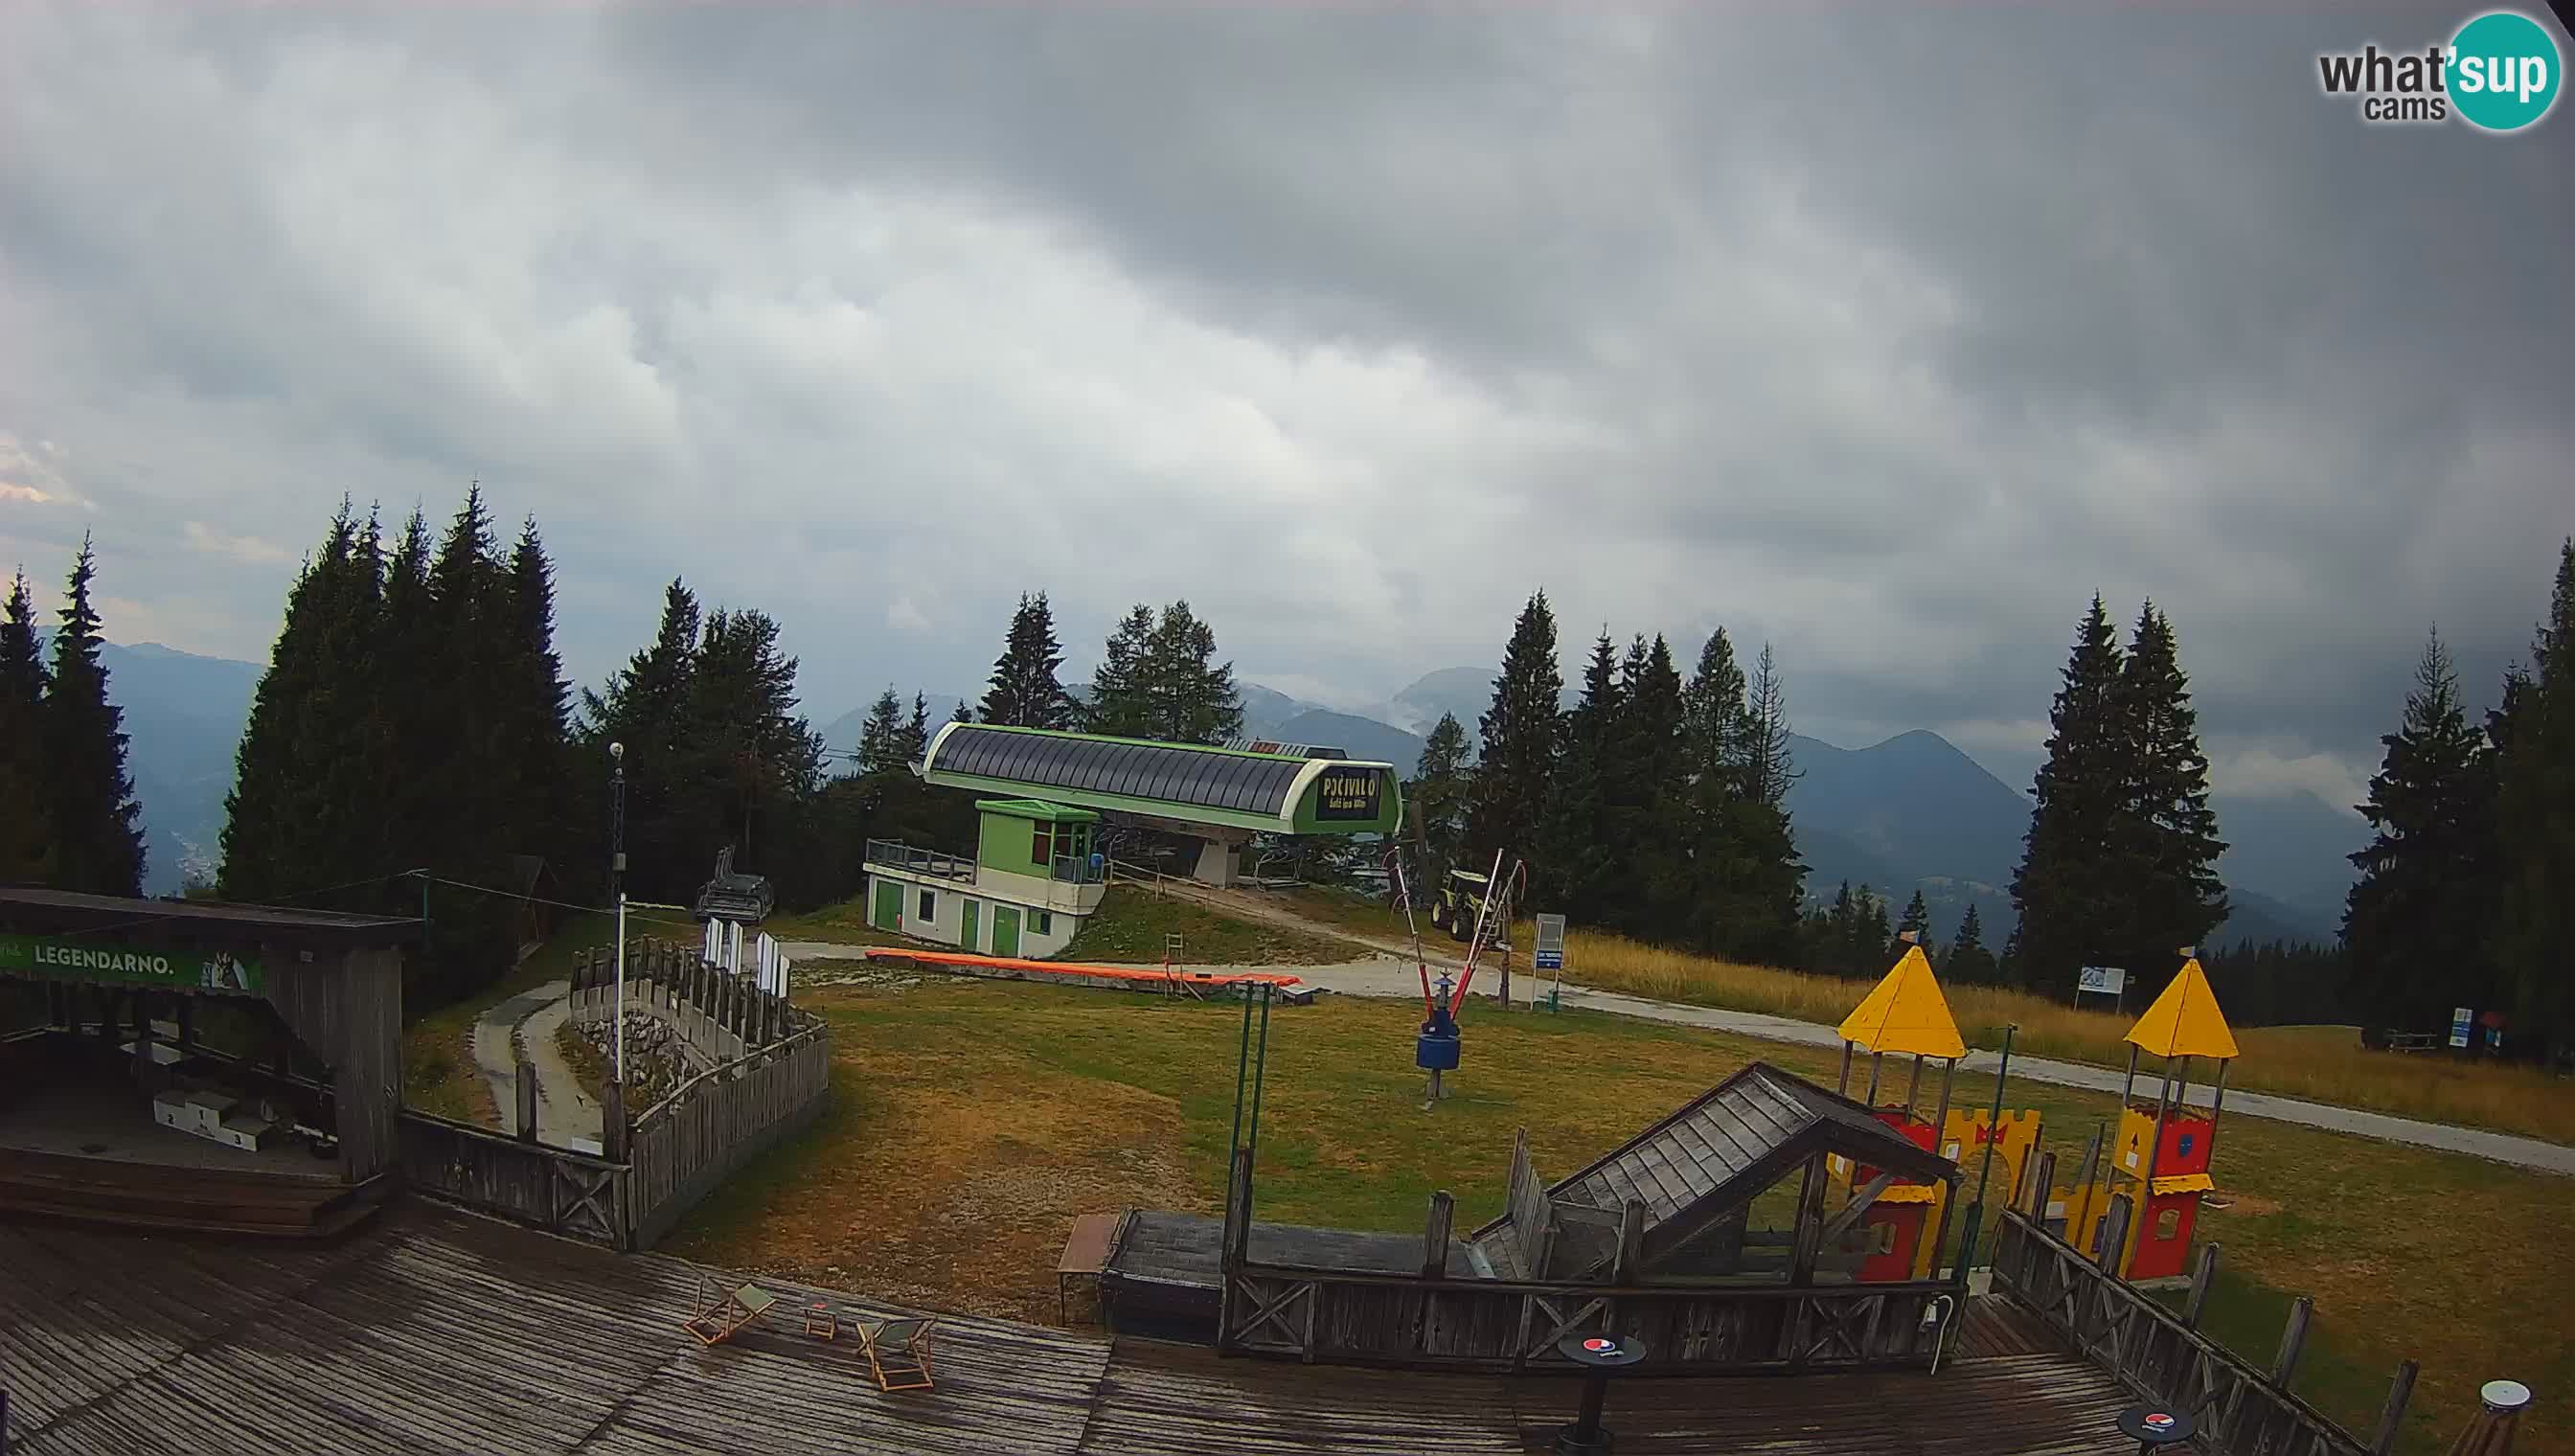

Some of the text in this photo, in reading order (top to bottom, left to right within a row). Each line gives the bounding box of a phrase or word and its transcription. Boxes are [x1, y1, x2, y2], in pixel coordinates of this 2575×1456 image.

[34, 944, 175, 975] LEGENDARNO.
[168, 1113, 174, 1124] 2
[235, 1134, 241, 1145] 3
